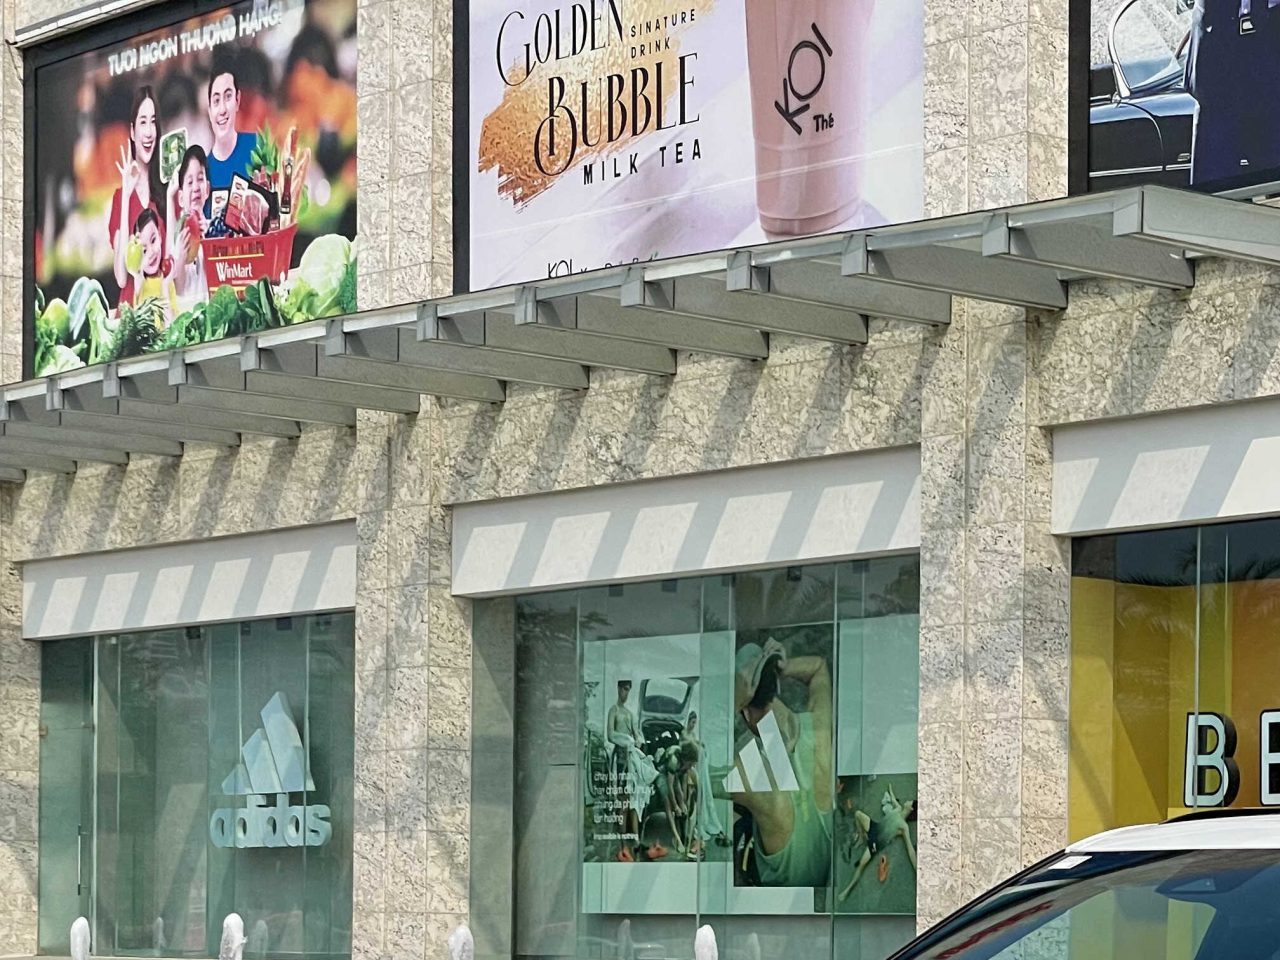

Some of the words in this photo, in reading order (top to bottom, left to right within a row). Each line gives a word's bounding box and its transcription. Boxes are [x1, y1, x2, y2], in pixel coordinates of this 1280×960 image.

[496, 0, 623, 87] GOLDEN
[630, 8, 695, 37] SINATURE
[630, 37, 671, 59] DRINK
[774, 22, 833, 135] KOI
[534, 53, 700, 176] BUBBLE
[813, 113, 834, 133] Thé
[583, 152, 639, 185] MILK
[659, 138, 701, 167] TEA
[215, 261, 253, 281] WinMart
[210, 793, 332, 849] adidas
